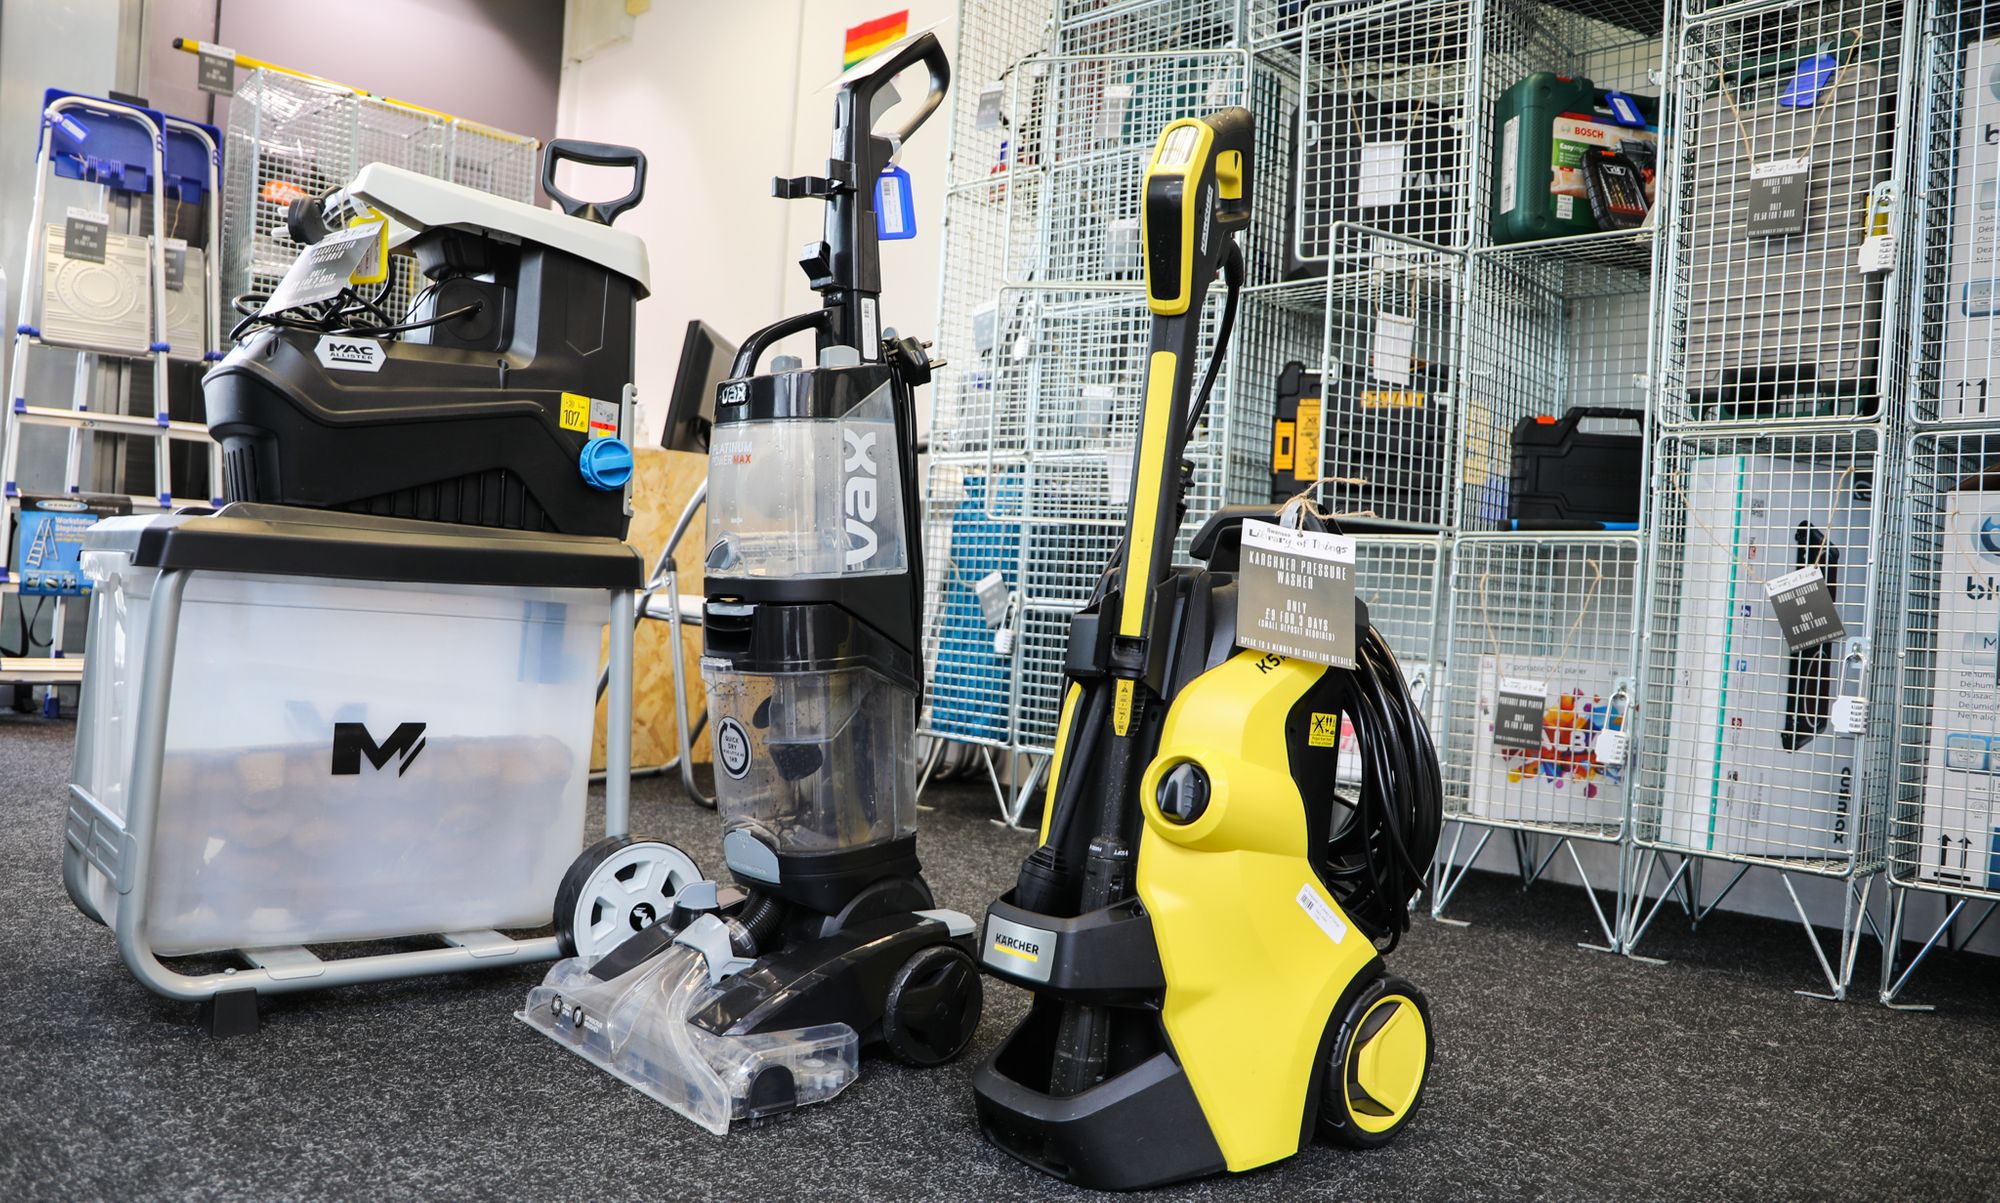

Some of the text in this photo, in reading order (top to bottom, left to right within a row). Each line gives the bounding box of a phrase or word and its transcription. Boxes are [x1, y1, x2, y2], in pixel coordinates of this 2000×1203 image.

[1574, 126, 1604, 140] BOSCH
[329, 343, 374, 356] MAC
[329, 352, 373, 361] ALLISTER
[563, 409, 581, 427] 107
[712, 441, 753, 455] PLATINUM
[1297, 537, 1307, 547] of
[1312, 538, 1349, 555] Things
[1249, 551, 1347, 581] KARCHNER PRESSURE
[1277, 570, 1314, 590] WASHER
[1286, 599, 1307, 615] ONLY
[1265, 607, 1276, 621] £9
[1280, 610, 1295, 625] FOR
[1307, 616, 1329, 632] DAYS
[1256, 653, 1281, 674] K5
[725, 735, 739, 743] QUICK
[1834, 767, 1851, 844] cusimax
